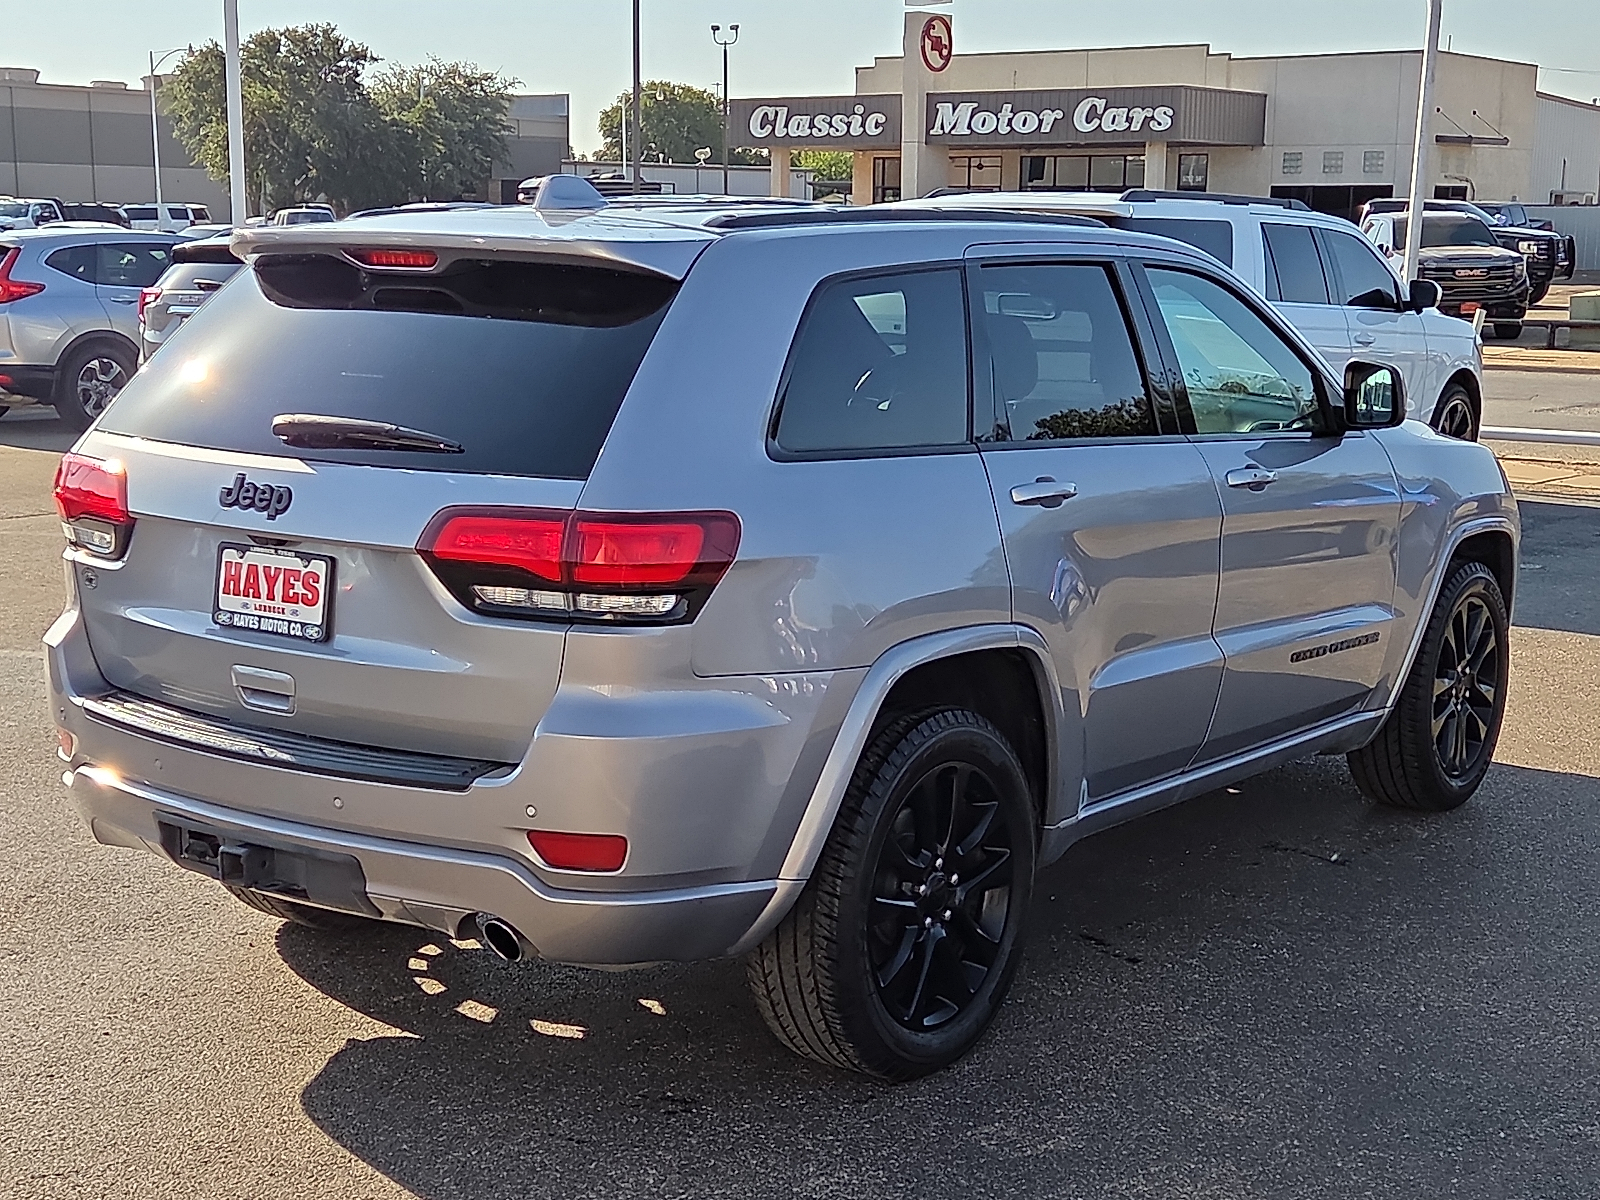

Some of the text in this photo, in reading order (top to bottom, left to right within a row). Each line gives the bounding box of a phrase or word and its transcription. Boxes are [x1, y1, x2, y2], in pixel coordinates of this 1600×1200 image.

[749, 96, 1174, 138] Classic Motor Cars
[1455, 268, 1488, 277] GMC
[219, 473, 293, 520] Jeep
[222, 561, 320, 607] HAYES
[233, 613, 259, 629] HAYES
[260, 617, 288, 634] MOTOR
[289, 622, 303, 636] CO.
